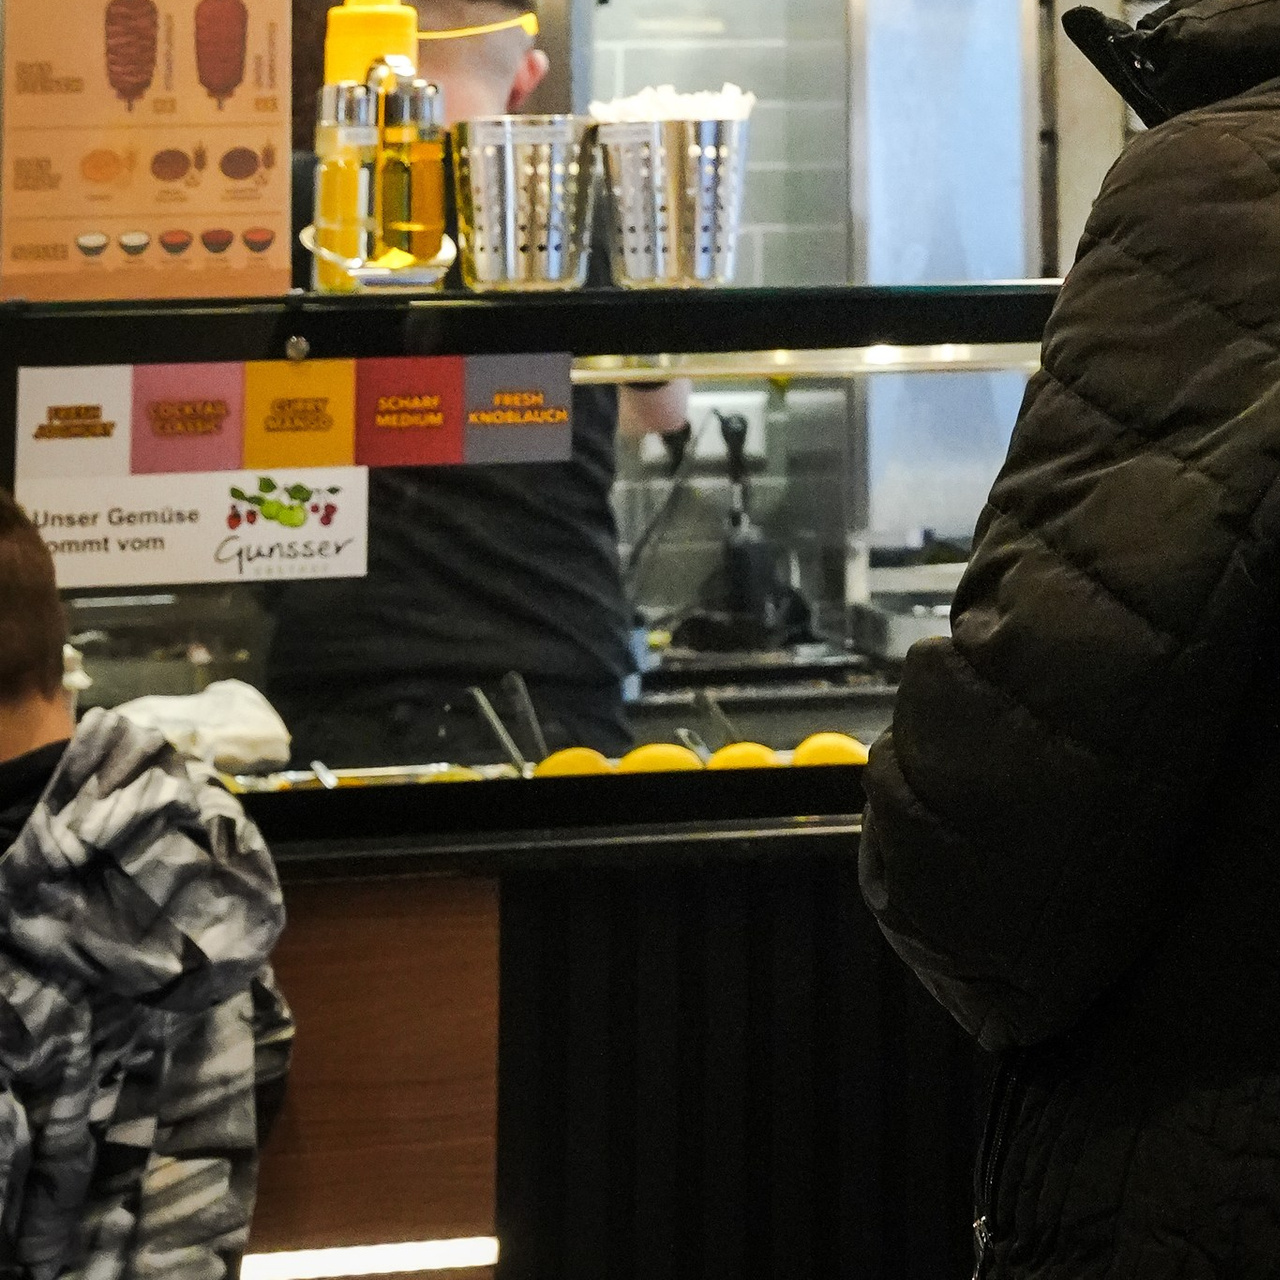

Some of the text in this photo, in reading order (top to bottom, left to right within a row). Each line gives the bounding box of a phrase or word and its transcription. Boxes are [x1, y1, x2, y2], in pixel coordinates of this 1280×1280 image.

[270, 397, 329, 414] CURRY
[377, 394, 441, 412] SCHARF
[493, 390, 544, 407] FRESH
[264, 414, 333, 431] MANGO
[374, 411, 444, 429] MEDIUM
[468, 407, 568, 425] KNOBLAUCH
[33, 506, 200, 528] Unser Gemüse
[49, 536, 165, 554] ommt vom
[213, 535, 354, 575] Gunsser
